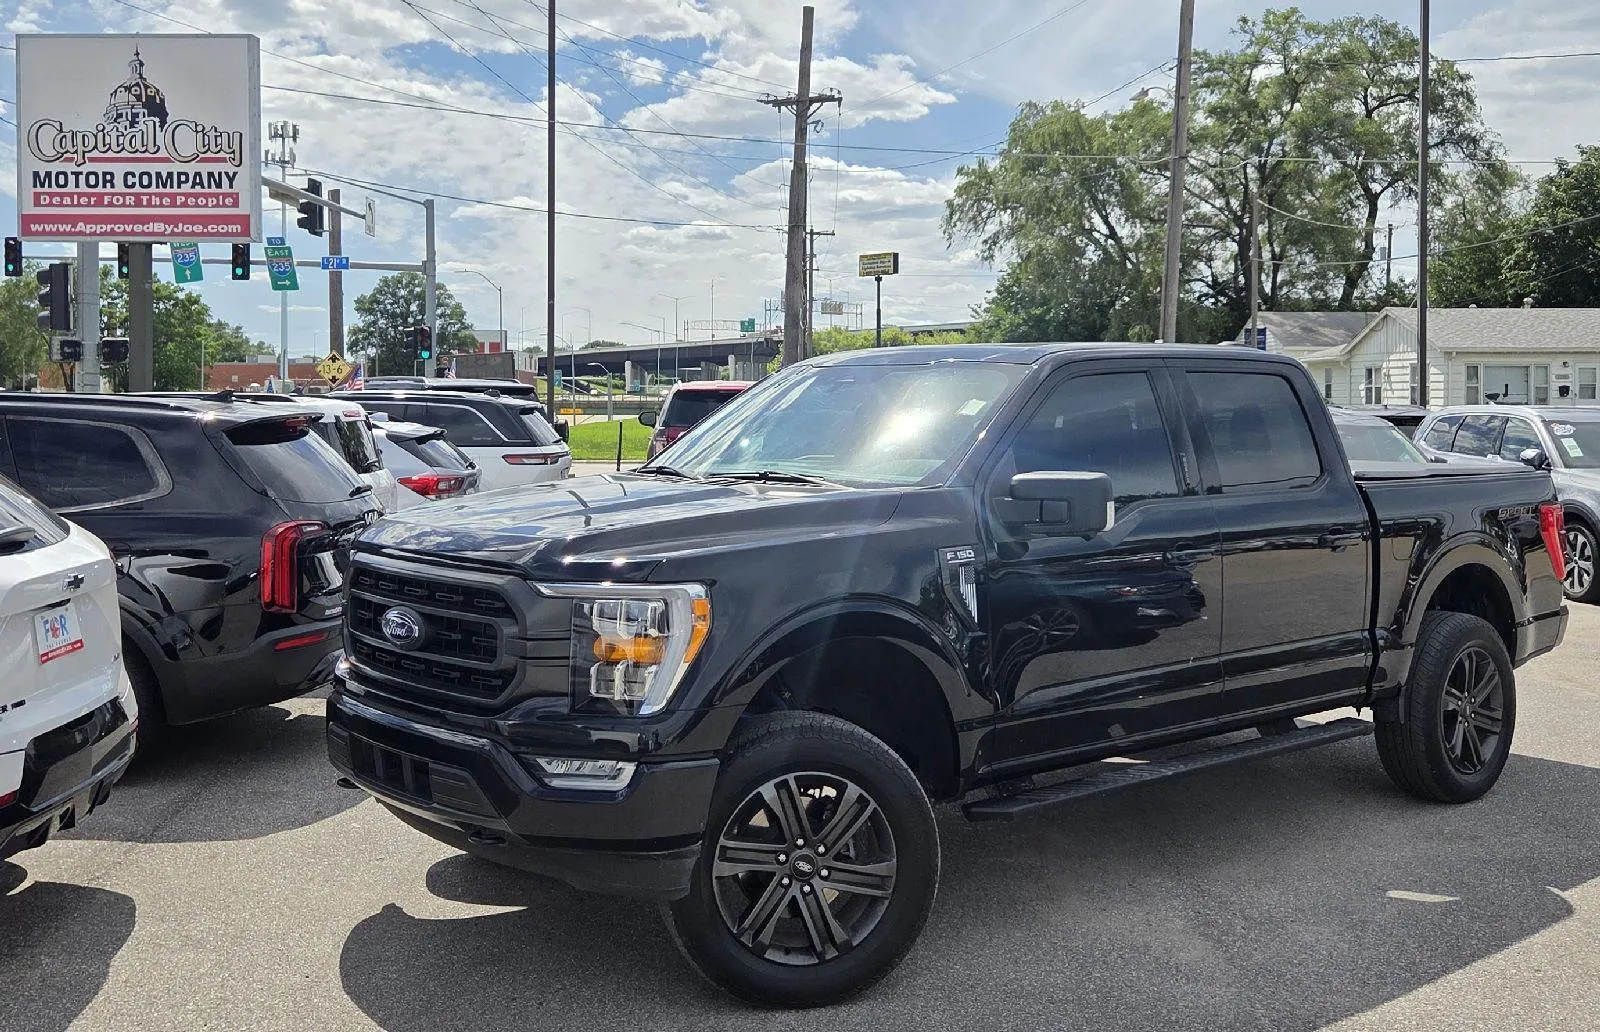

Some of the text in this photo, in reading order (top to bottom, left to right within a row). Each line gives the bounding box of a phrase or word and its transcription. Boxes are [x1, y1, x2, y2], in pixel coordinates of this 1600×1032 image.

[28, 119, 242, 167] Capital City
[32, 171, 239, 189] MOTOR COMPANY
[40, 194, 234, 207] Dealer FOR The People
[176, 252, 196, 263] 235
[272, 262, 291, 271] 235
